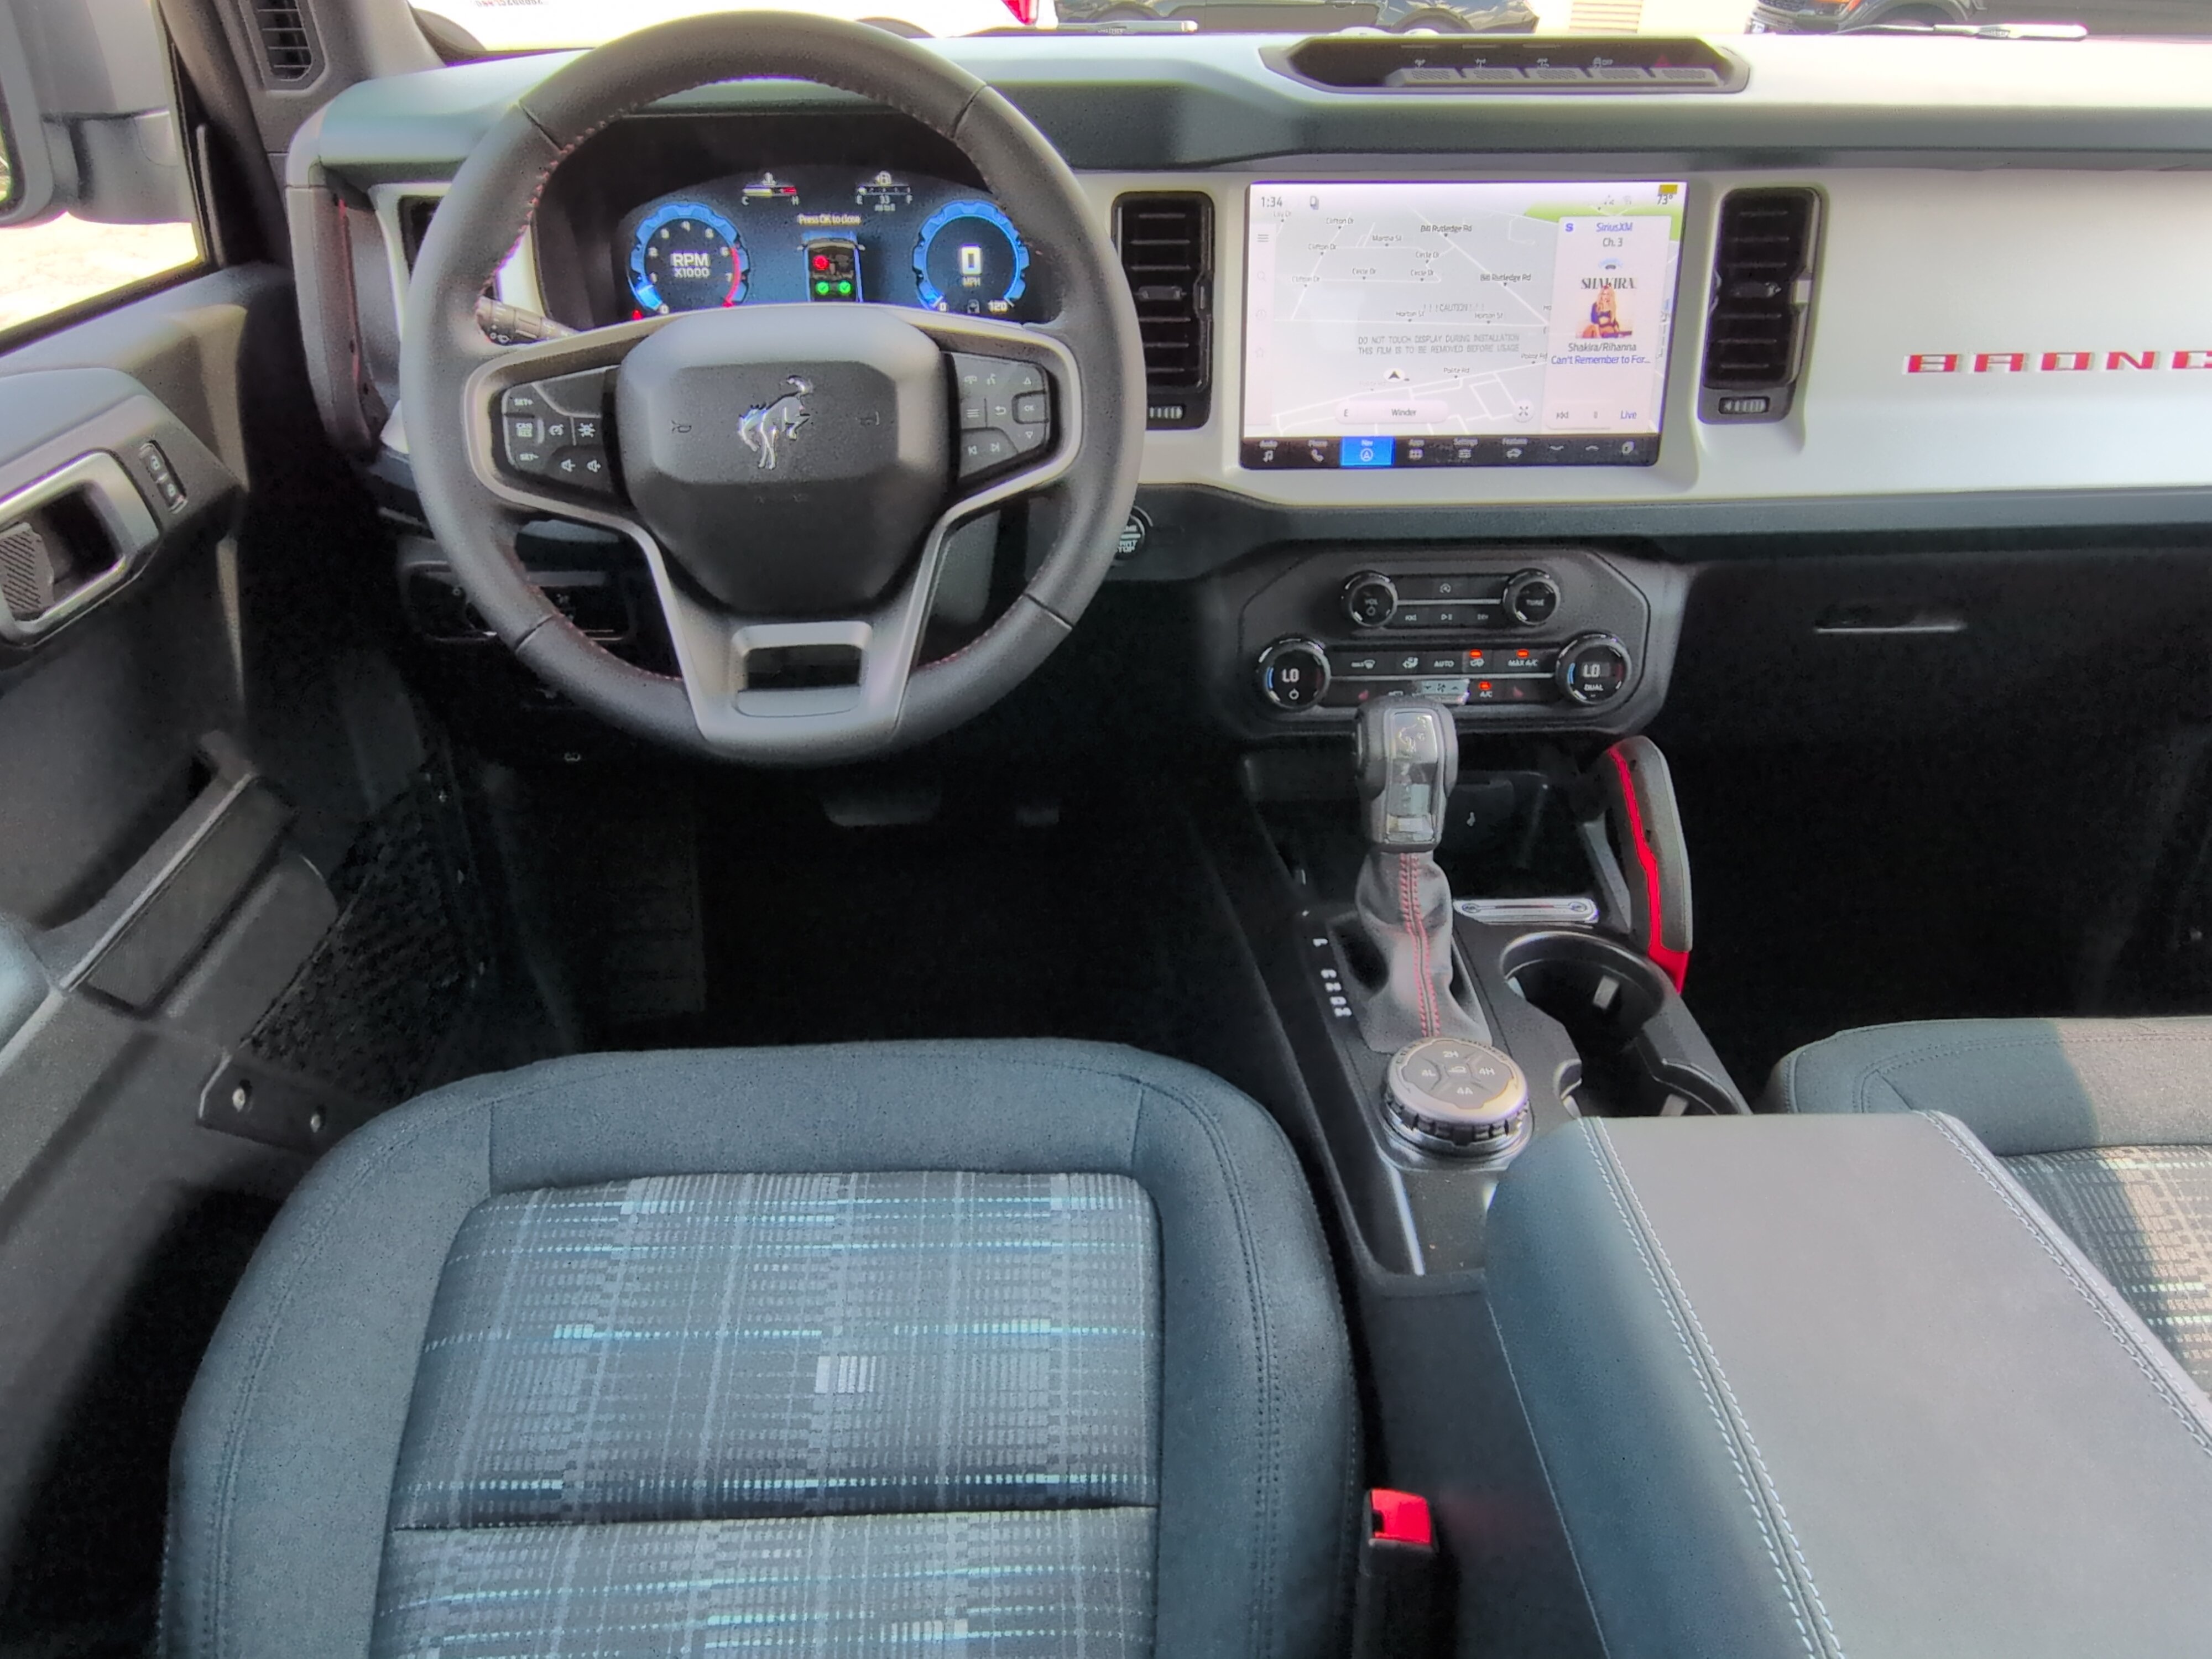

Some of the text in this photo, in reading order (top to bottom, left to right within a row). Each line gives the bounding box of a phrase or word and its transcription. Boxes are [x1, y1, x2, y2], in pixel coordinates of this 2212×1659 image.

[1261, 196, 1283, 207] 1:34
[1596, 222, 1633, 232] SiriusXM
[1602, 237, 1623, 247] Ch. 3
[671, 253, 709, 267] RPM
[961, 246, 981, 274] 0
[674, 268, 711, 278] X1000
[988, 300, 1008, 311] 120
[1567, 342, 1637, 352] Shakira/Rihanna
[1551, 355, 1573, 365] Can't
[1575, 354, 1620, 364] Remember
[1621, 356, 1630, 364] to
[1620, 410, 1637, 419] Live
[1583, 664, 1600, 678] LO
